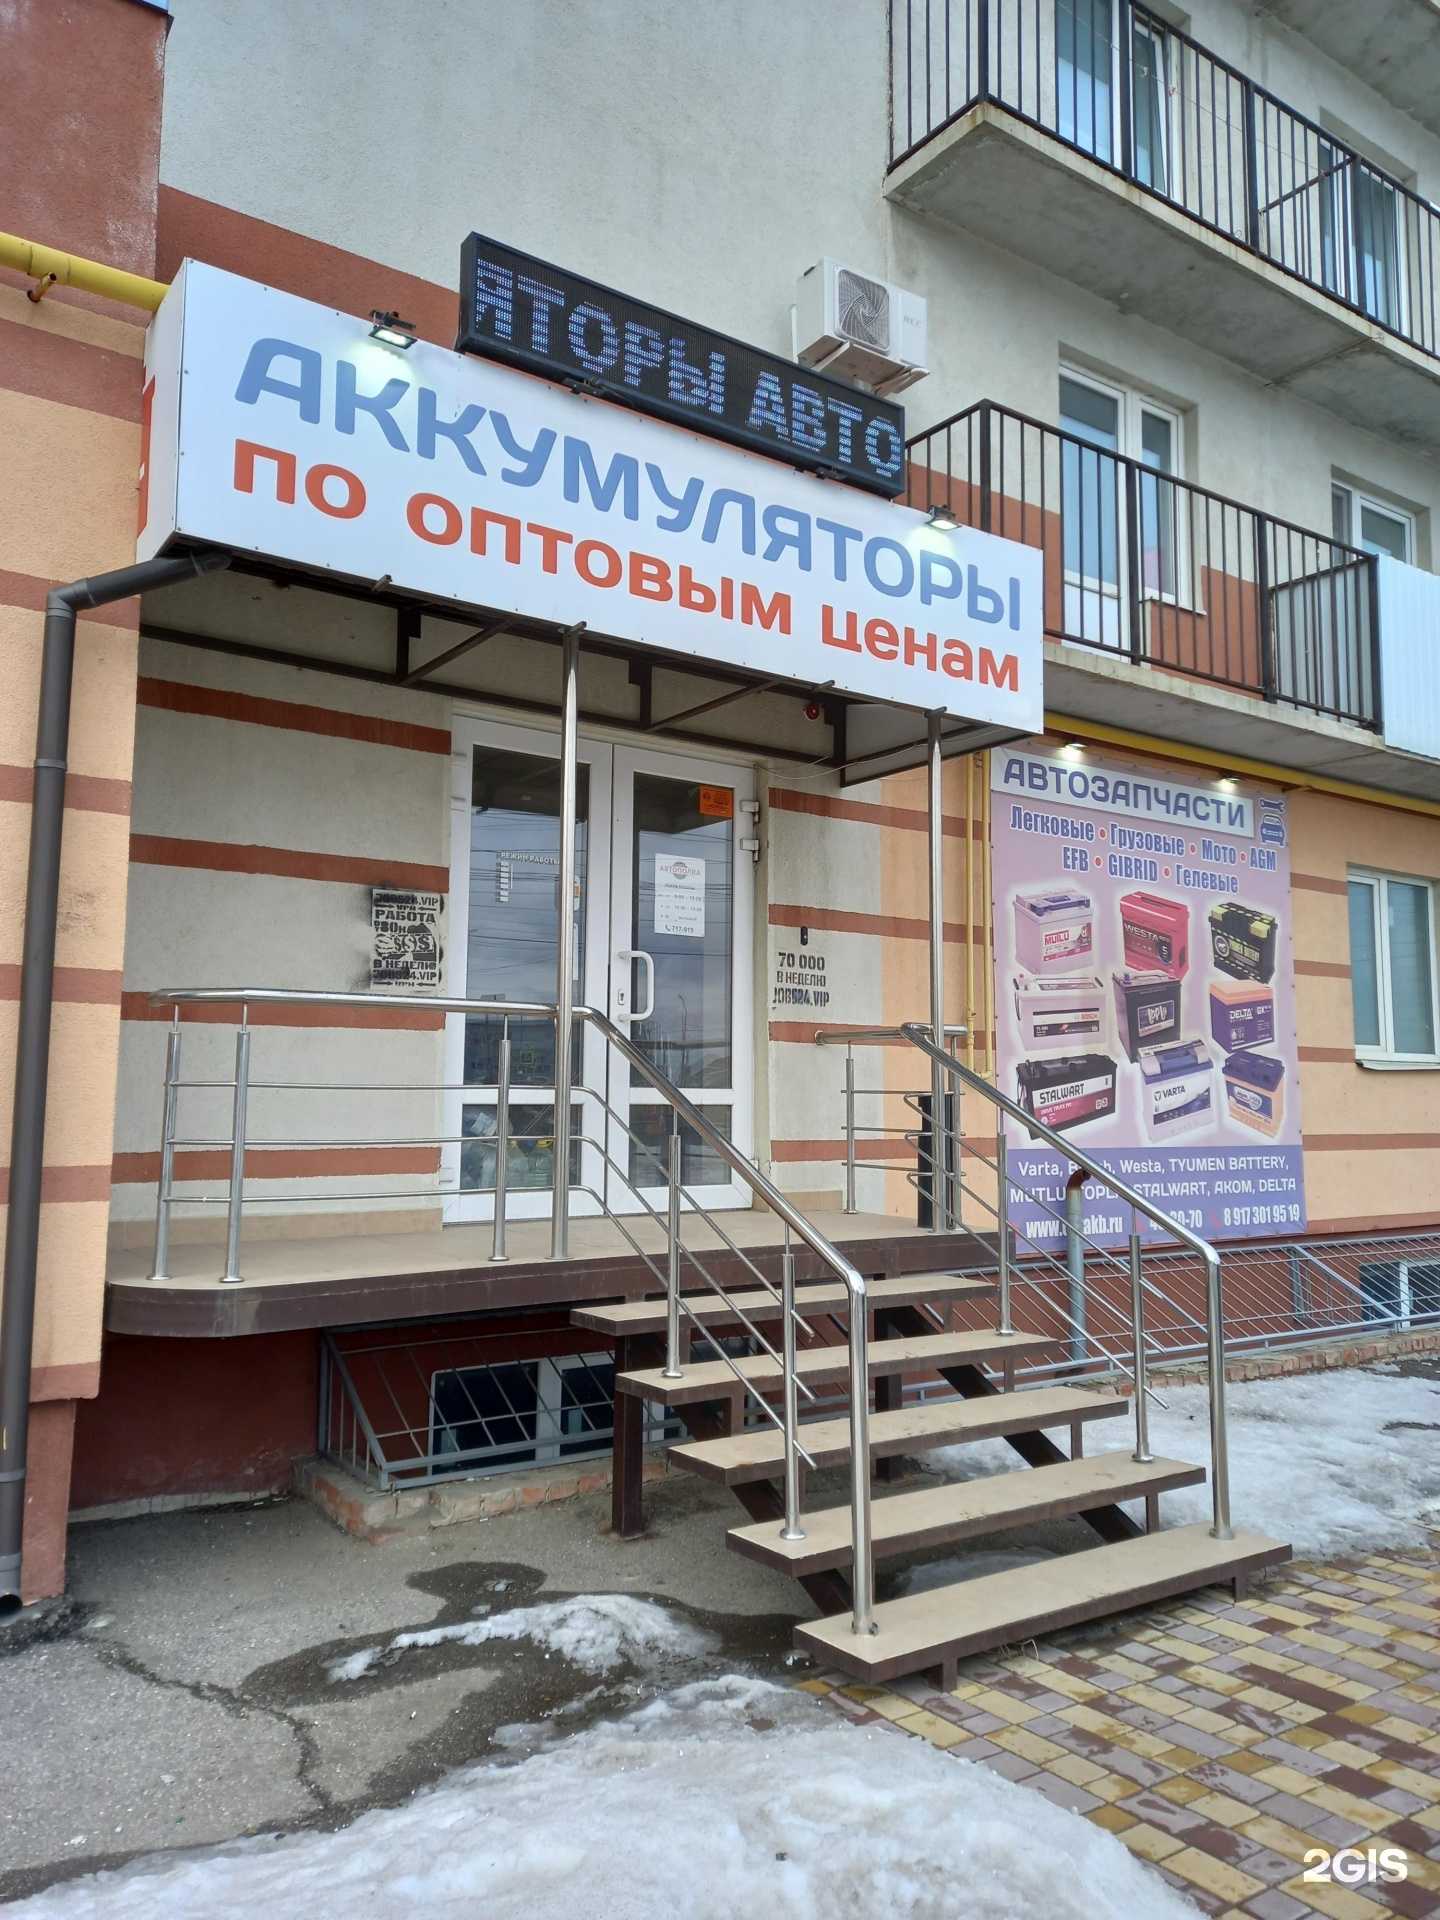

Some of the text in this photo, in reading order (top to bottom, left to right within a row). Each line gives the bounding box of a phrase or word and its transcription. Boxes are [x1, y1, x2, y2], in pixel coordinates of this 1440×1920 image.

[235, 337, 1020, 631] АККУМУЛЯТОРЫ
[821, 603, 1019, 692] ценам
[1003, 758, 1245, 828] АВТОЗАПЧАСТИ
[1010, 805, 1277, 871] Легковые Грузовые Мото AGM
[1063, 847, 1238, 893] EFB GIBRID Гелевые
[375, 909, 436, 923] РАБОТА
[1124, 921, 1159, 942] WESTA
[776, 970, 826, 987] В НЕДЕЛЮ
[1229, 1008, 1253, 1021] DELTA
[1039, 1083, 1085, 1104] STALWART
[1162, 1085, 1186, 1098] VARTA
[1018, 1161, 1063, 1177] Varta,
[1120, 1159, 1165, 1174] Westa,
[1168, 1157, 1225, 1172] TYUMEN
[1229, 1156, 1289, 1171] BATTERY,
[1133, 1181, 1211, 1197] STALWART,
[1214, 1179, 1256, 1195] AKOM,
[1259, 1178, 1296, 1192] DELTA
[1233, 1207, 1251, 1226] 917
[1253, 1206, 1271, 1224] 301
[1273, 1205, 1287, 1223] 95
[1288, 1204, 1300, 1222] 19
